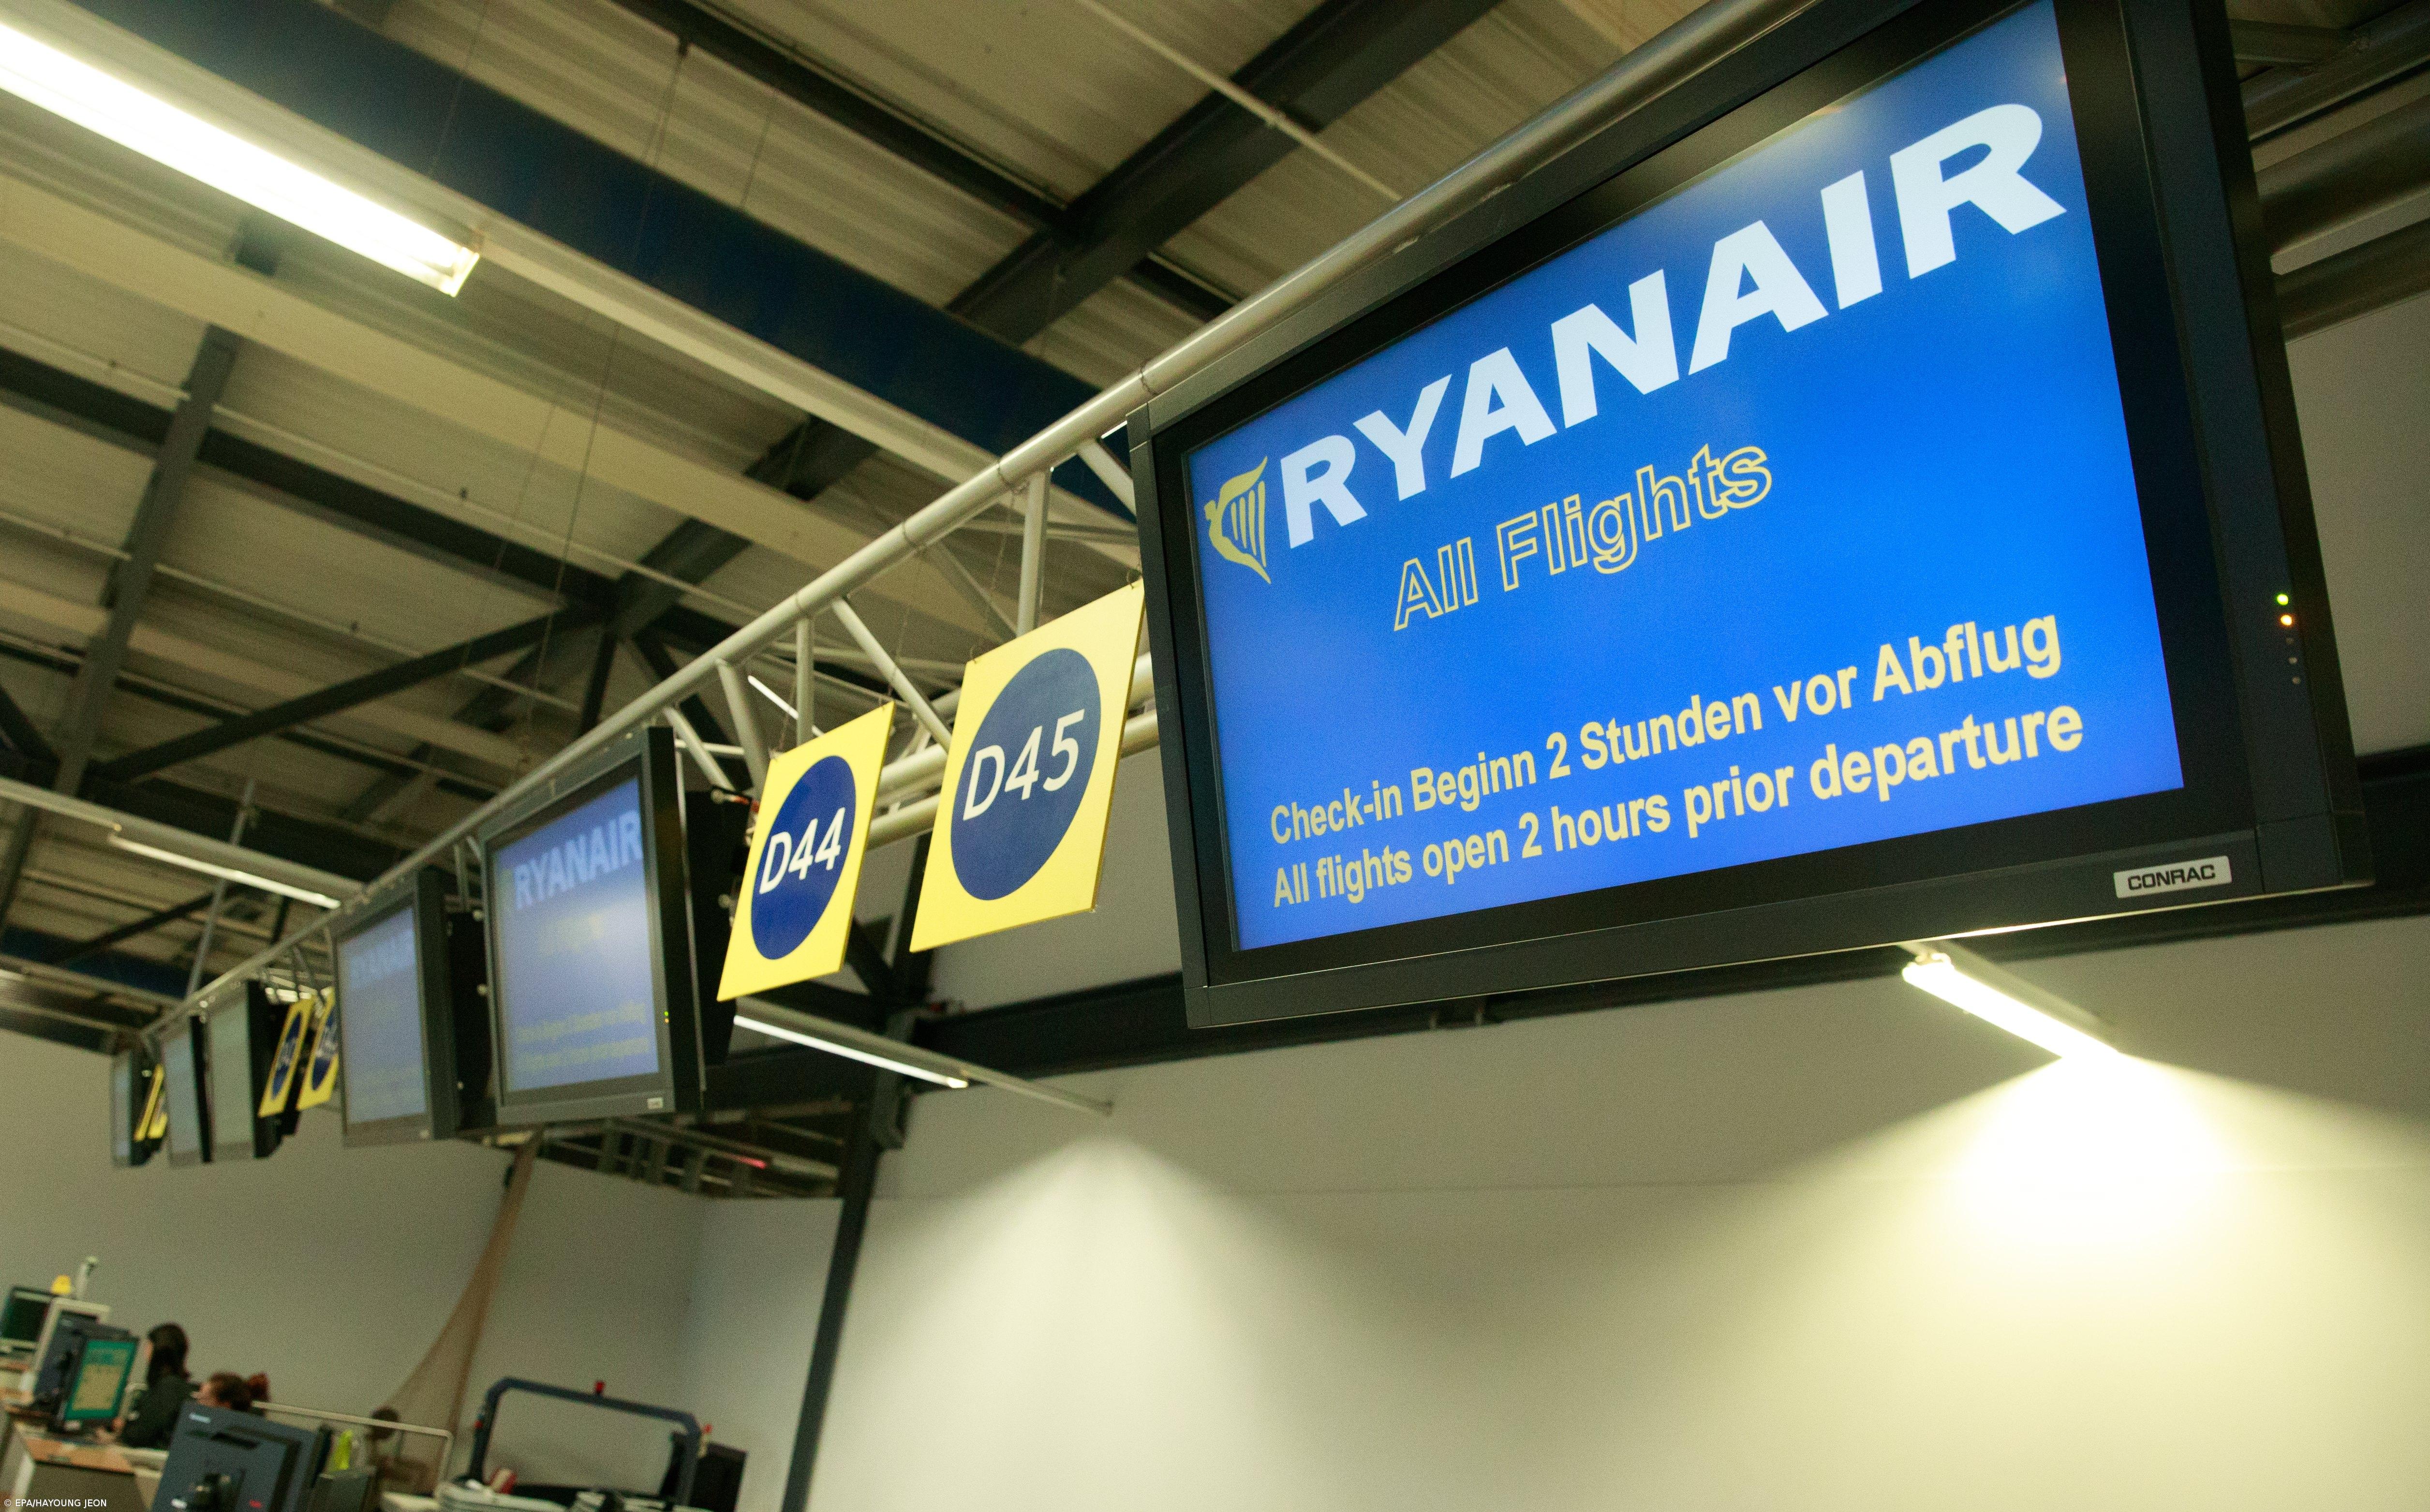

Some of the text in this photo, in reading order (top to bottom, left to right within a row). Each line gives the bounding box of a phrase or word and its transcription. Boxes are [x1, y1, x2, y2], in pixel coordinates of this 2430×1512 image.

[1280, 103, 2067, 549] RYANAIR
[1393, 443, 1773, 632] All Flights
[962, 708, 1085, 821] D45
[1271, 614, 2062, 845] Check-in Beginn 2 Stunden vor Abflug
[514, 810, 643, 909] RYANAIR
[758, 807, 846, 895] D44
[1273, 705, 2083, 908] All flights open 2 hours prior departure
[2128, 864, 2215, 890] CONRAC
